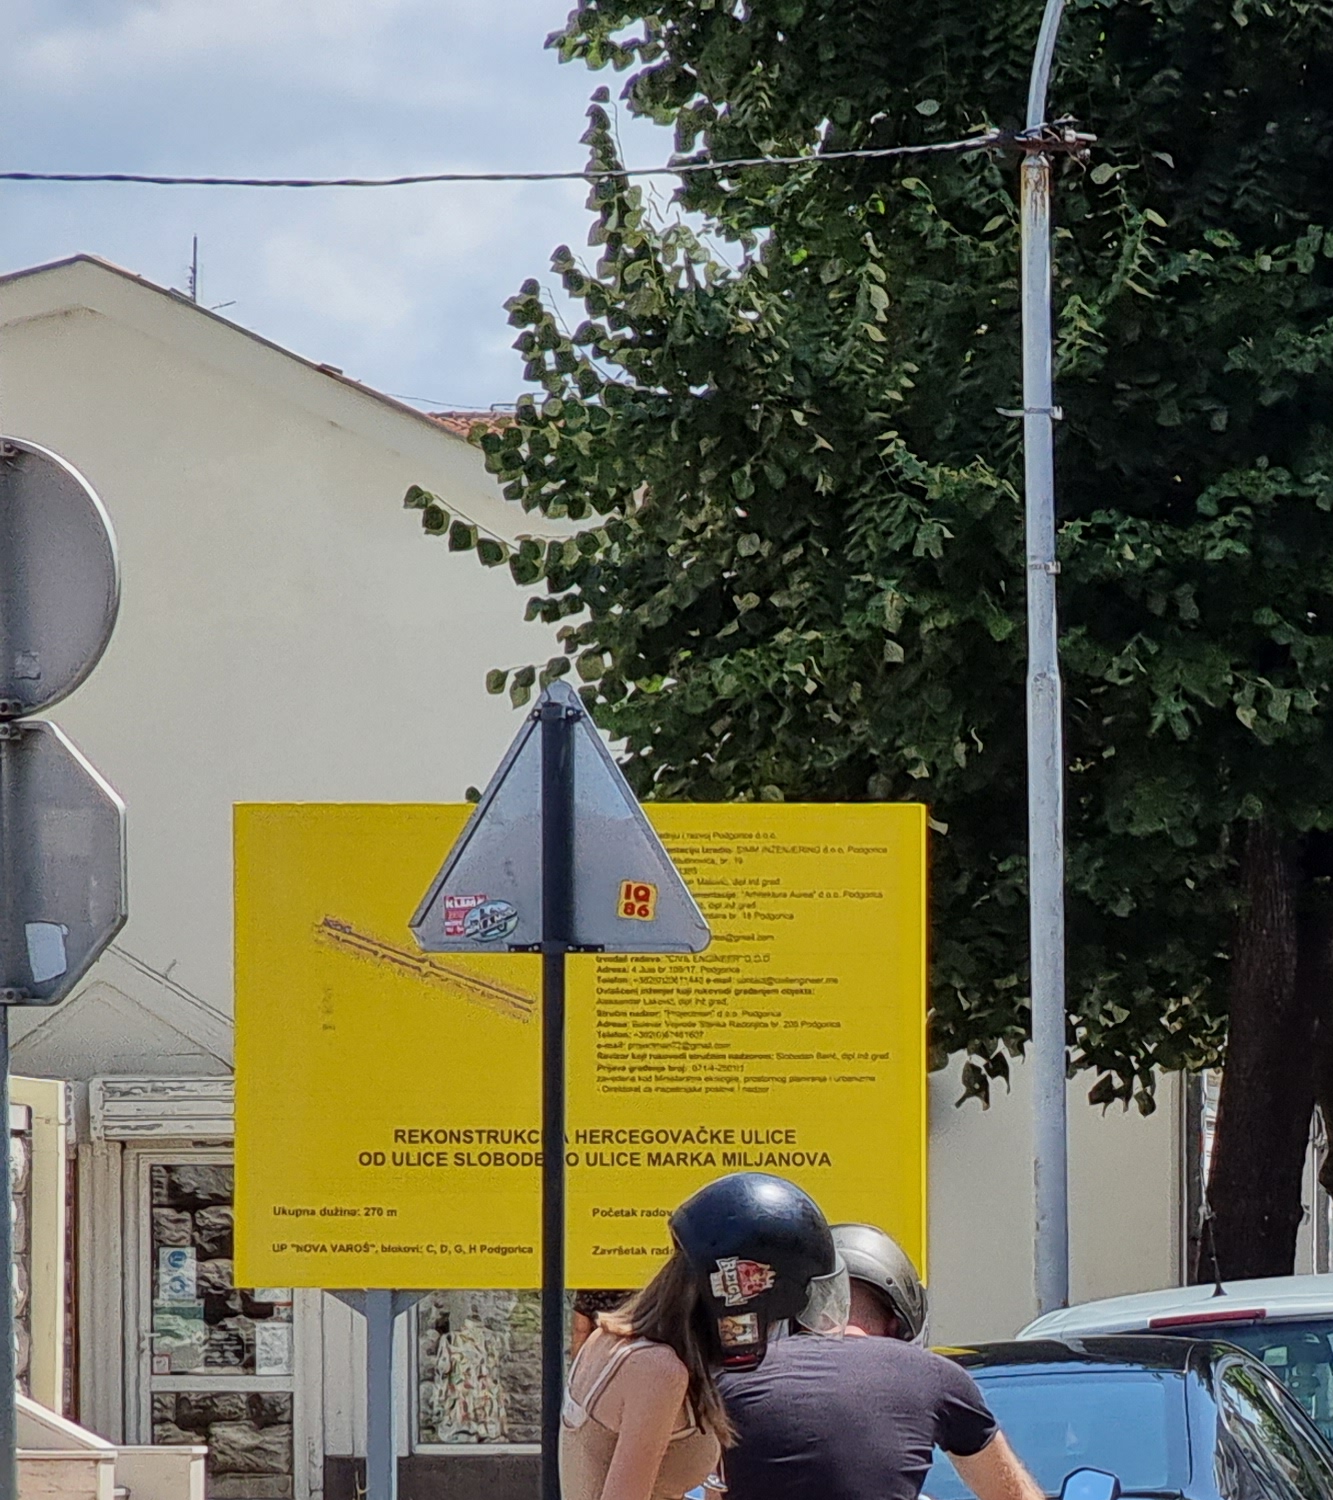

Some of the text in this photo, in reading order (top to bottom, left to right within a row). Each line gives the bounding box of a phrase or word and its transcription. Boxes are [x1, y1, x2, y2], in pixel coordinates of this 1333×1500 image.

[624, 902, 649, 918] 86
[394, 1125, 797, 1145] REKONSTRUKC HERCEGOVAČKE ULICE
[358, 1152, 386, 1168] OD
[392, 1152, 448, 1168] ULICE
[453, 1152, 545, 1168] SLOBODE
[586, 1152, 642, 1168] ULICE
[647, 1152, 715, 1168] MARKA
[722, 1152, 832, 1168] MILJANOVA
[273, 1206, 316, 1219] Ukupna
[364, 1207, 384, 1216] 270
[386, 1209, 398, 1217] m
[592, 1207, 638, 1218] Početak
[480, 1244, 534, 1256] Podgorica
[592, 1245, 648, 1256] Završetak
